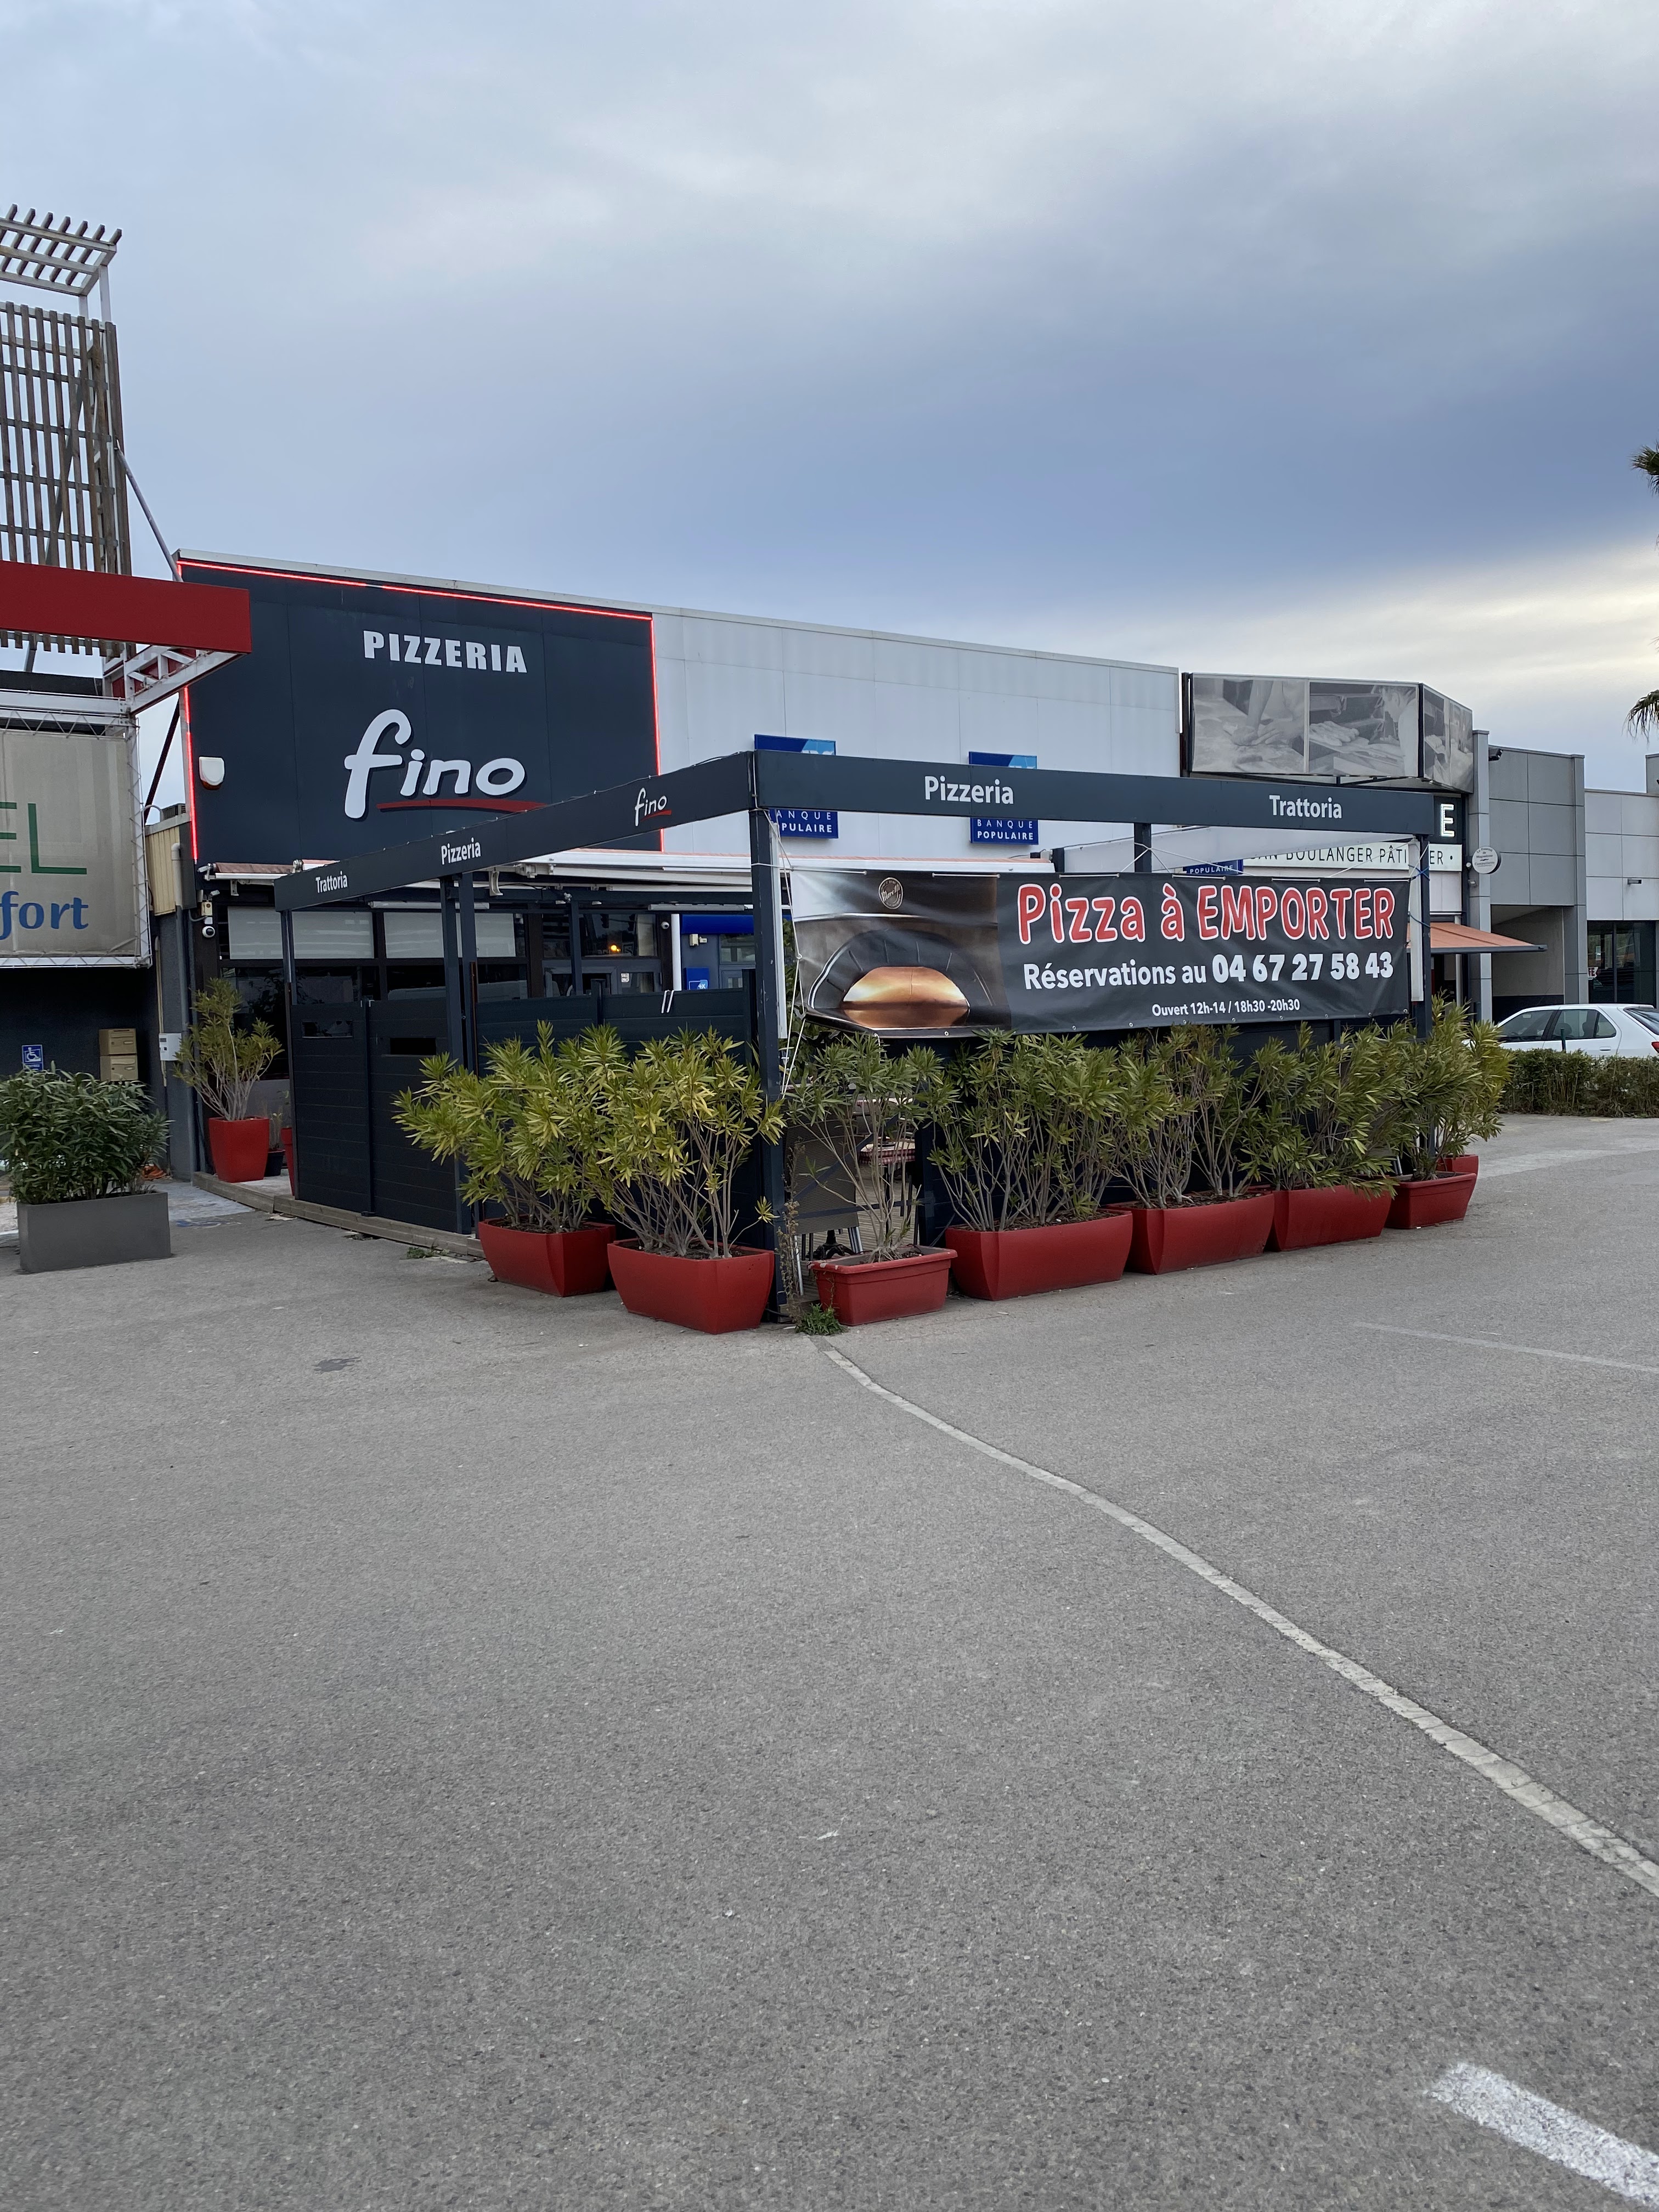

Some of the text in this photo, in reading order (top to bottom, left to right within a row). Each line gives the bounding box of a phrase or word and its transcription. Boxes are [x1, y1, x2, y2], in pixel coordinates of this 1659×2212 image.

[363, 630, 527, 673] PIZZERIA
[344, 708, 525, 818] fino
[924, 775, 1014, 804] Pizzeria
[634, 787, 667, 827] fino
[776, 809, 831, 821] ANQUE
[1269, 794, 1342, 819] Trattoria
[782, 822, 832, 833] PULAIRE
[977, 819, 1032, 829] BANQUE
[1440, 803, 1455, 837] E
[977, 831, 1034, 840] POPULAIRE
[441, 837, 482, 865] Pizzeria
[1286, 845, 1443, 865] BOULANGER PÂTIER
[315, 870, 348, 894] Trattoria
[1189, 865, 1233, 874] POPULAIRE
[1018, 883, 1395, 945] Pizza à EMPORTER
[1023, 951, 1393, 989] Réservations au 04 67 27 58 43
[1152, 998, 1300, 1017] Ouvert 12h-14 / 18h30 -20h30
